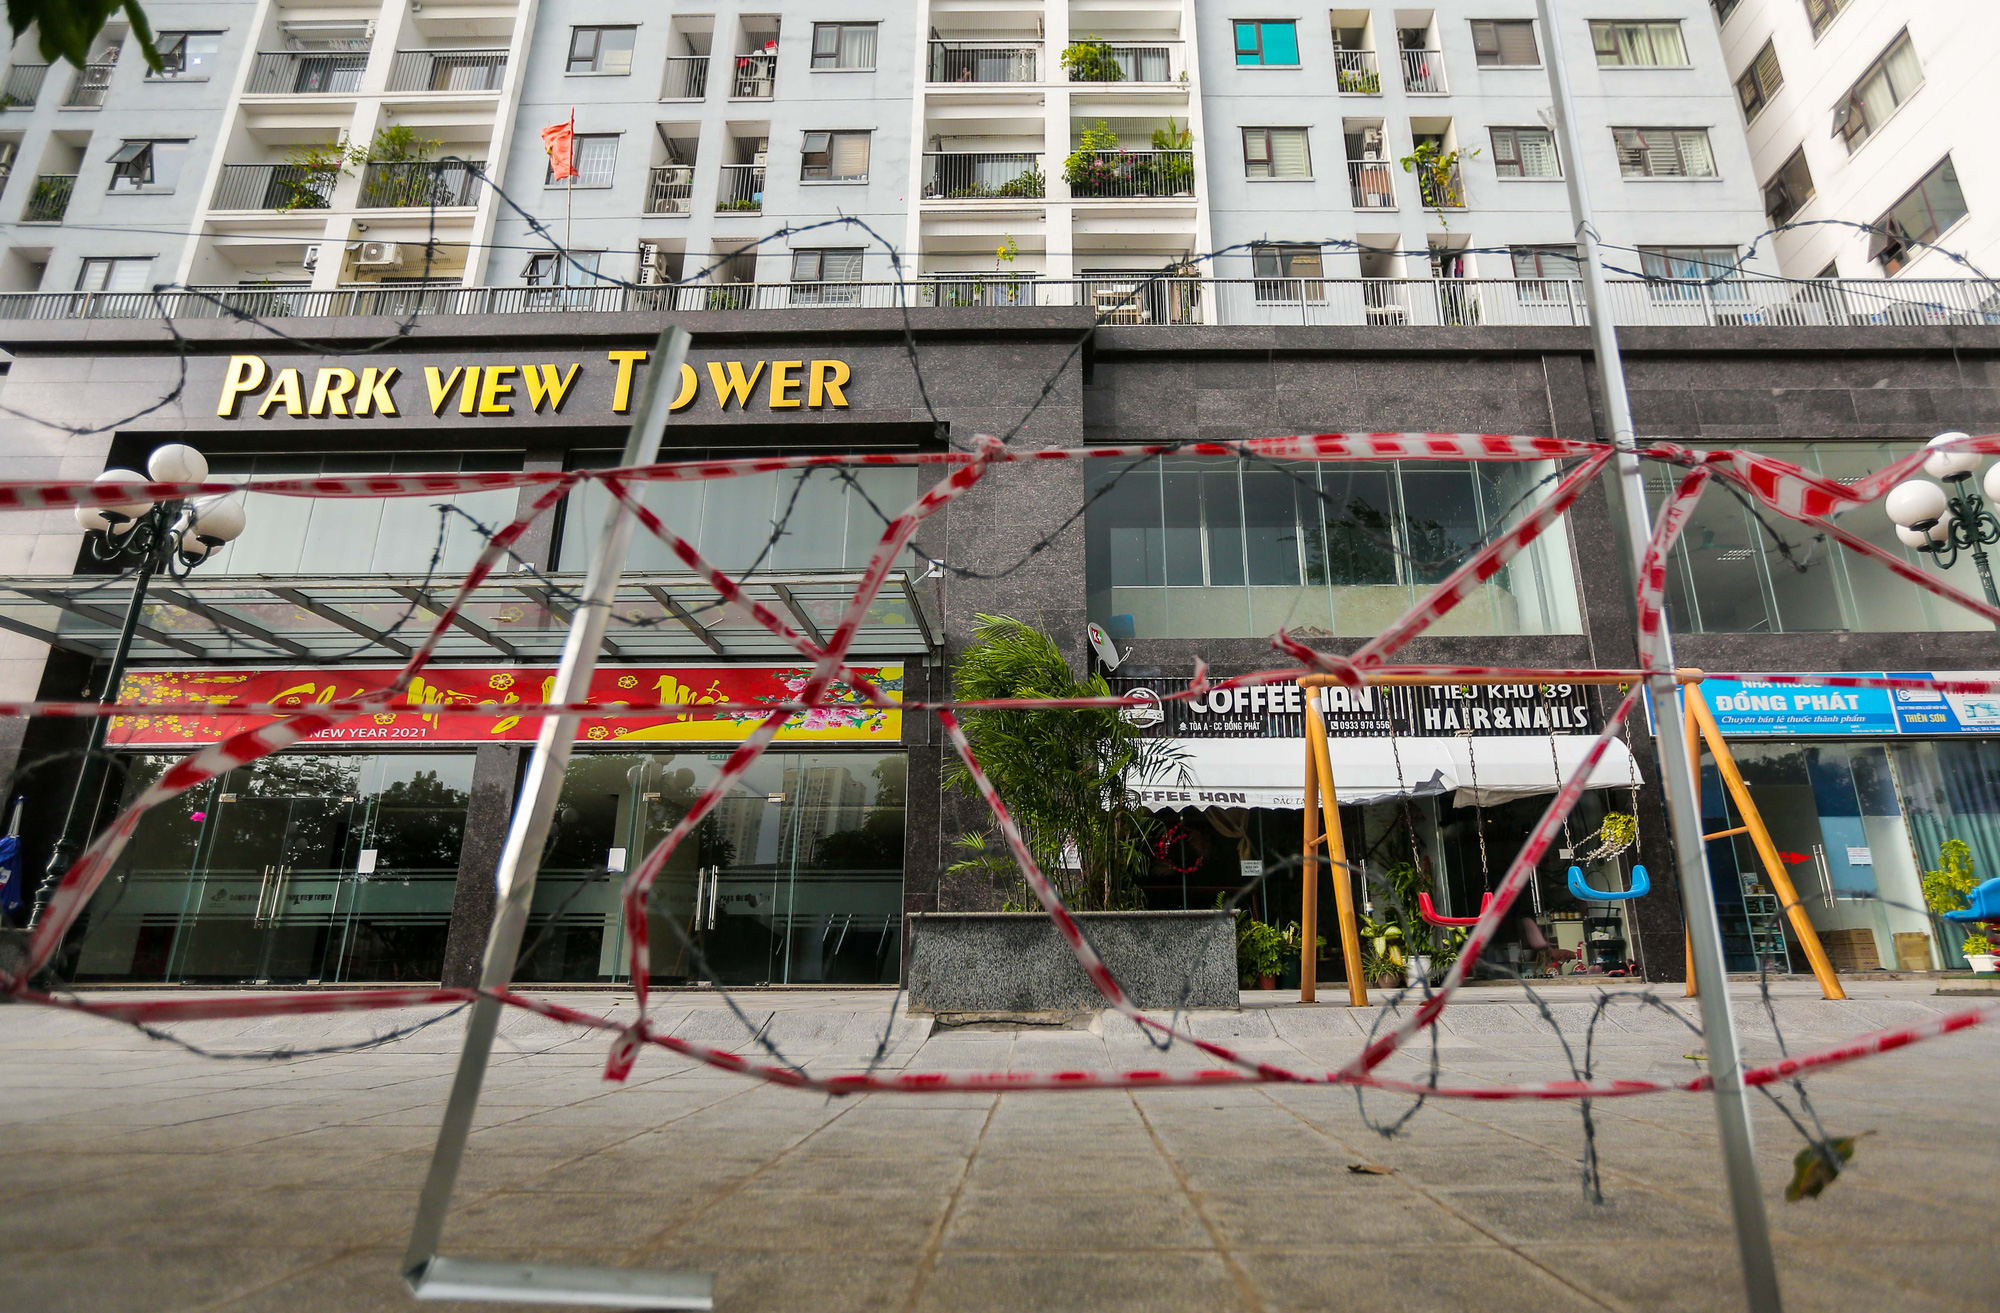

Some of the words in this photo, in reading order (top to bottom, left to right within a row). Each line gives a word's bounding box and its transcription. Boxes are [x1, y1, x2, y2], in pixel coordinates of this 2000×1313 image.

[216, 354, 400, 417] PARK
[423, 363, 582, 416] VIEW
[1487, 683, 1534, 700] KHU
[1188, 685, 1302, 714] COFFEE
[1715, 690, 1788, 711] ĐỒNG
[1793, 691, 1860, 711] PHÁT
[1721, 716, 1756, 725] Chuyên
[1757, 715, 1774, 724] bán
[1786, 714, 1812, 723] thuốc
[1814, 714, 1839, 723] thành
[1904, 712, 1928, 723] THIÊN
[1929, 713, 1947, 723] SƠN
[1189, 720, 1203, 731] TÒA
[1203, 722, 1209, 731] A
[1213, 722, 1222, 731] CC
[1224, 719, 1242, 731] ĐỒNG
[1243, 719, 1260, 731] PHÁT
[1340, 720, 1359, 730] 0933
[1360, 720, 1374, 730] 978
[1376, 720, 1390, 730] 556
[309, 728, 347, 738] NEW
[349, 728, 388, 738] YEAR
[391, 727, 428, 738] 2021
[1141, 791, 1192, 802] FFEE
[1198, 791, 1247, 803] HAN
